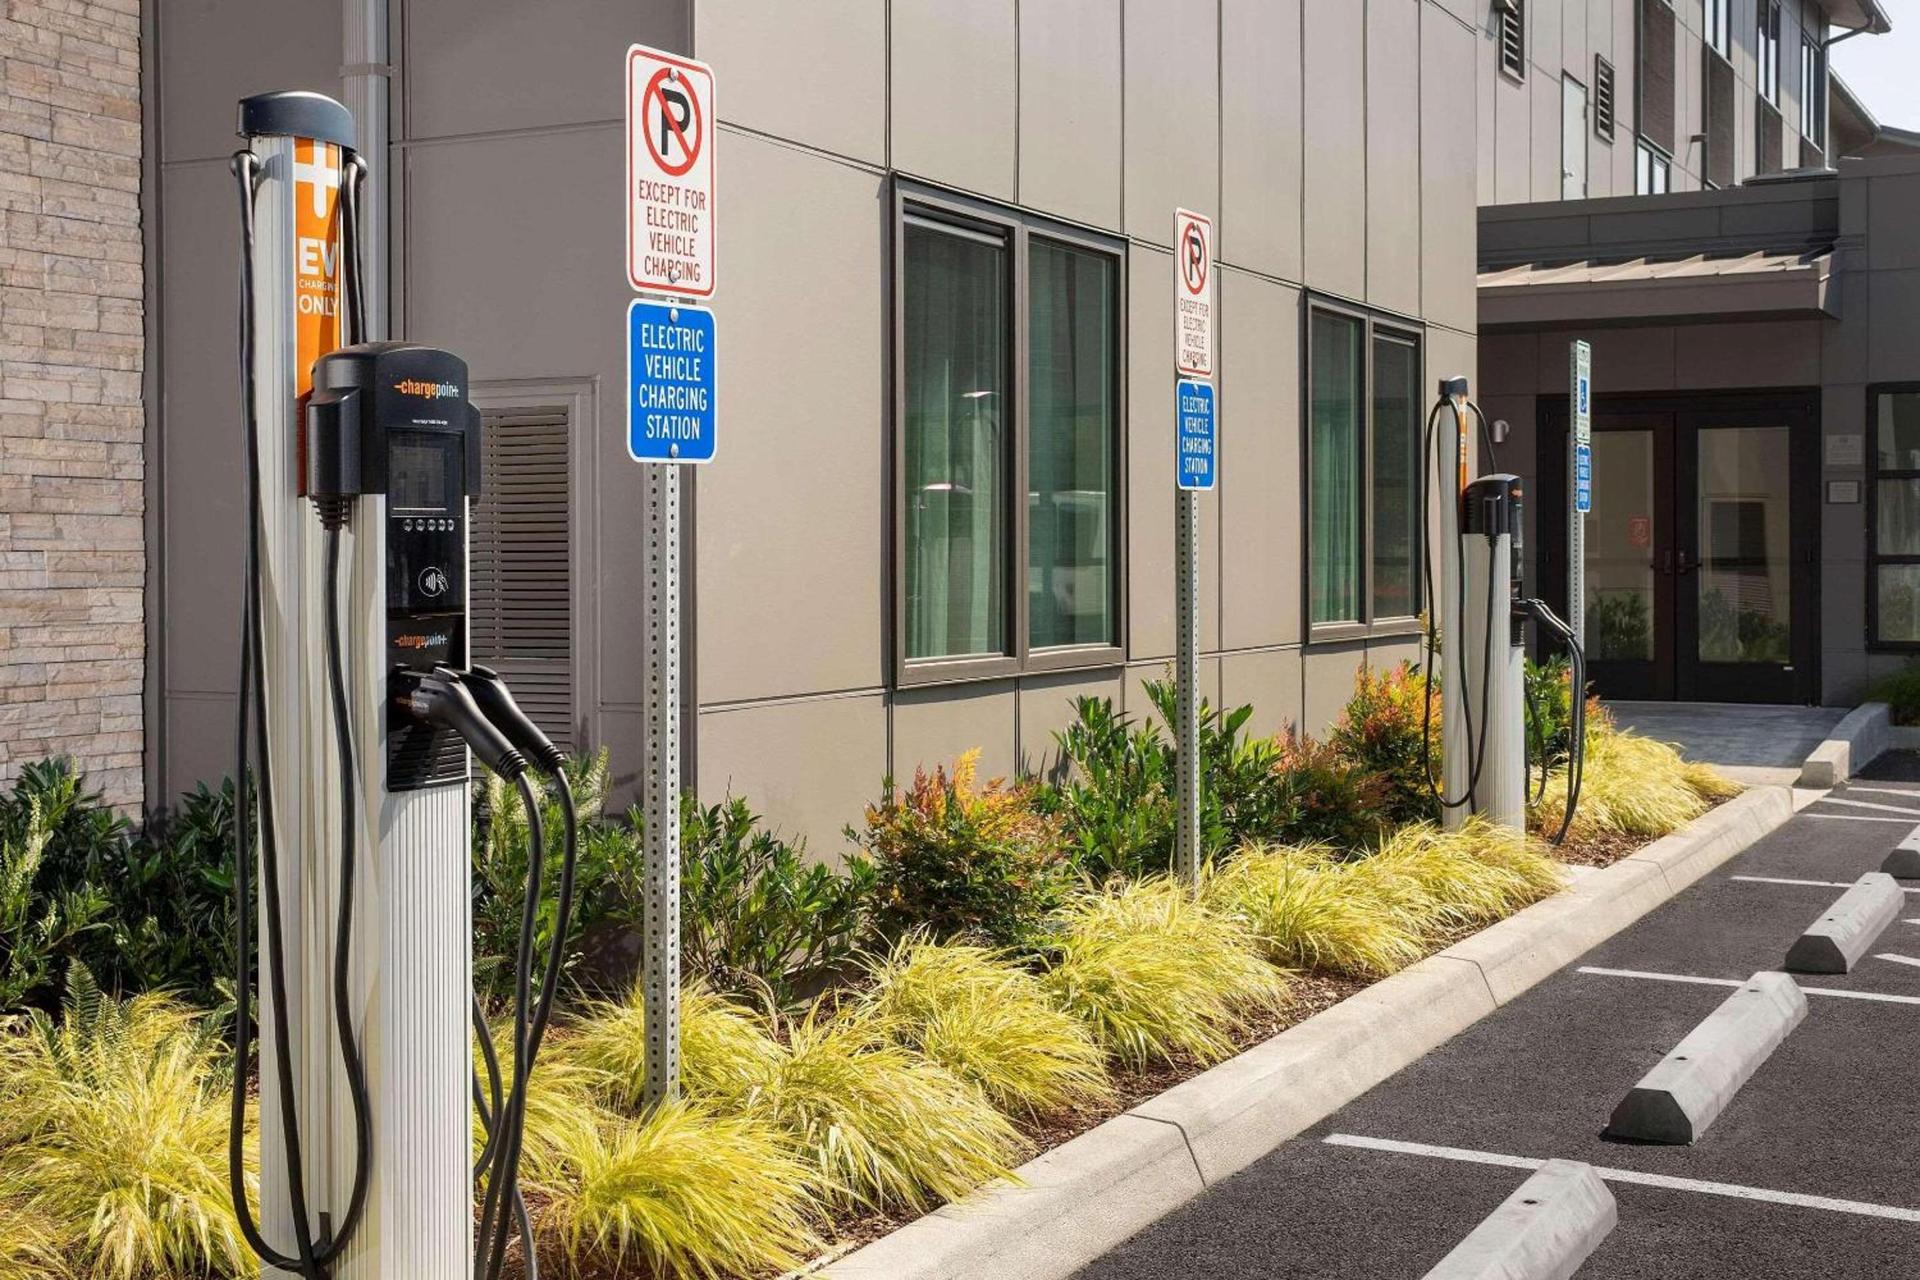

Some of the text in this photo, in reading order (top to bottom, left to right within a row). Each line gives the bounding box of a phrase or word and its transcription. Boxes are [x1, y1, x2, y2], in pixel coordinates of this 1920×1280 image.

[661, 87, 691, 156] P
[639, 179, 706, 211] EXCEPT FOR
[646, 206, 699, 234] ELECTRIC
[299, 237, 339, 277] EV
[649, 231, 696, 258] VEHICLE
[644, 255, 701, 282] CHARGING
[299, 293, 339, 317] ONLY
[641, 323, 705, 353] ELECTRIC
[645, 353, 701, 382] VEHICLE
[639, 383, 708, 412] CHARGING
[1182, 395, 1210, 415] ELECTRIC
[646, 414, 701, 440] STATION
[1184, 416, 1209, 435] VEHICLE
[1182, 436, 1212, 455] CHARGING
[1184, 457, 1208, 475] STATION
